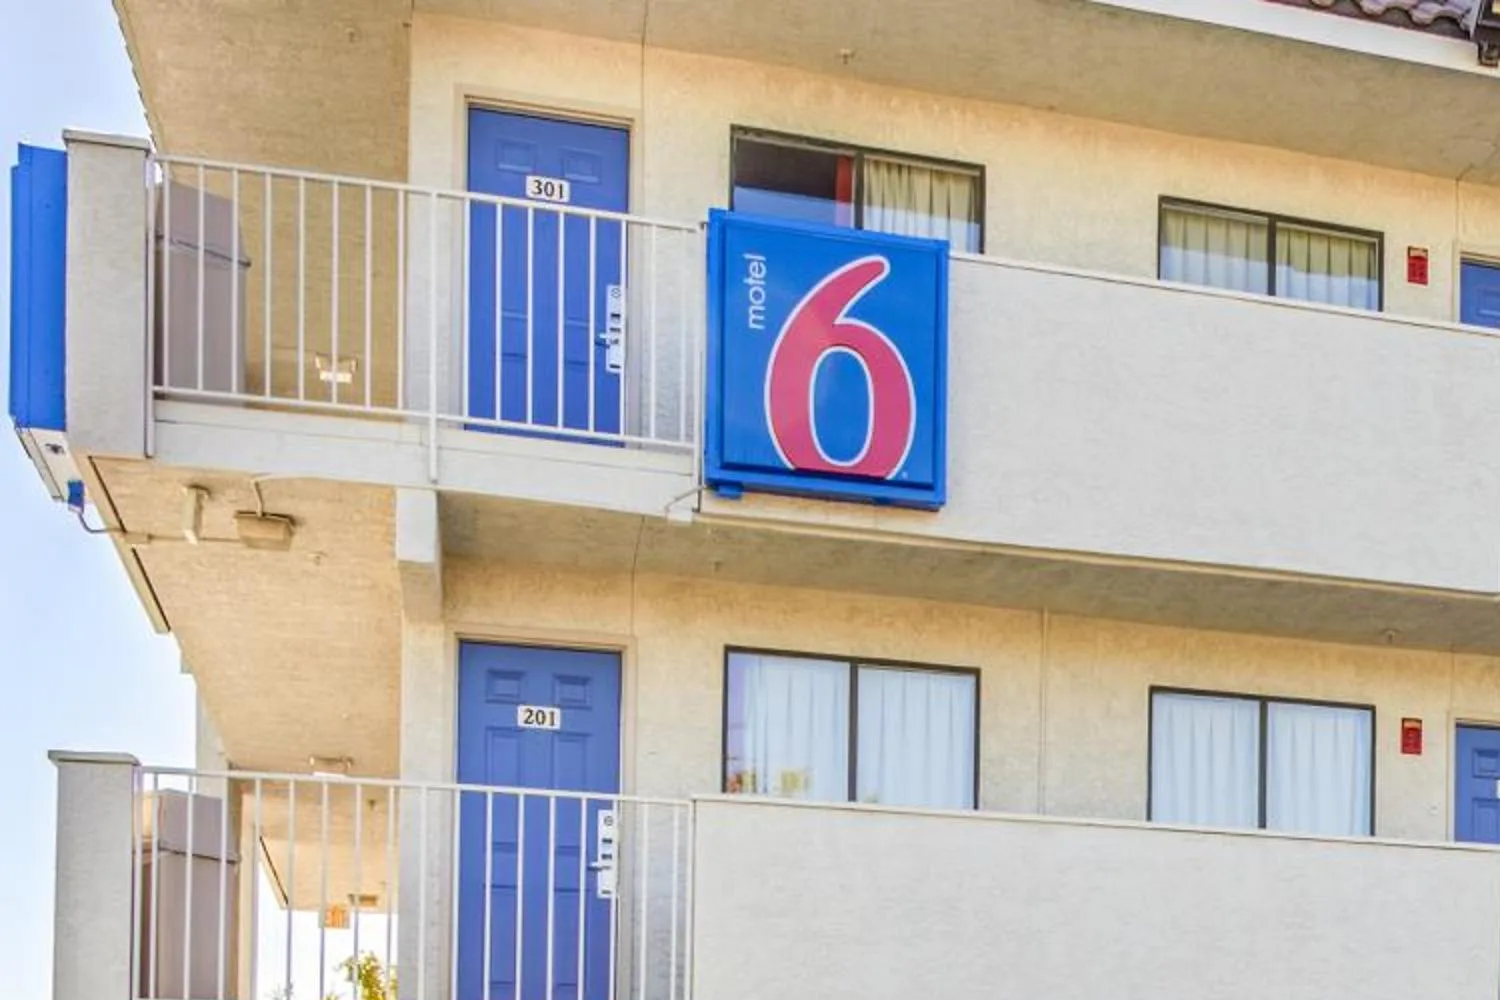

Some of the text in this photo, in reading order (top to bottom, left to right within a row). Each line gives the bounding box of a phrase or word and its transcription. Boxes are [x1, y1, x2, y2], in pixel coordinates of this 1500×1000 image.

[530, 179, 564, 199] 301
[743, 253, 767, 330] motel
[764, 255, 917, 480] 6
[523, 708, 556, 727] 201
